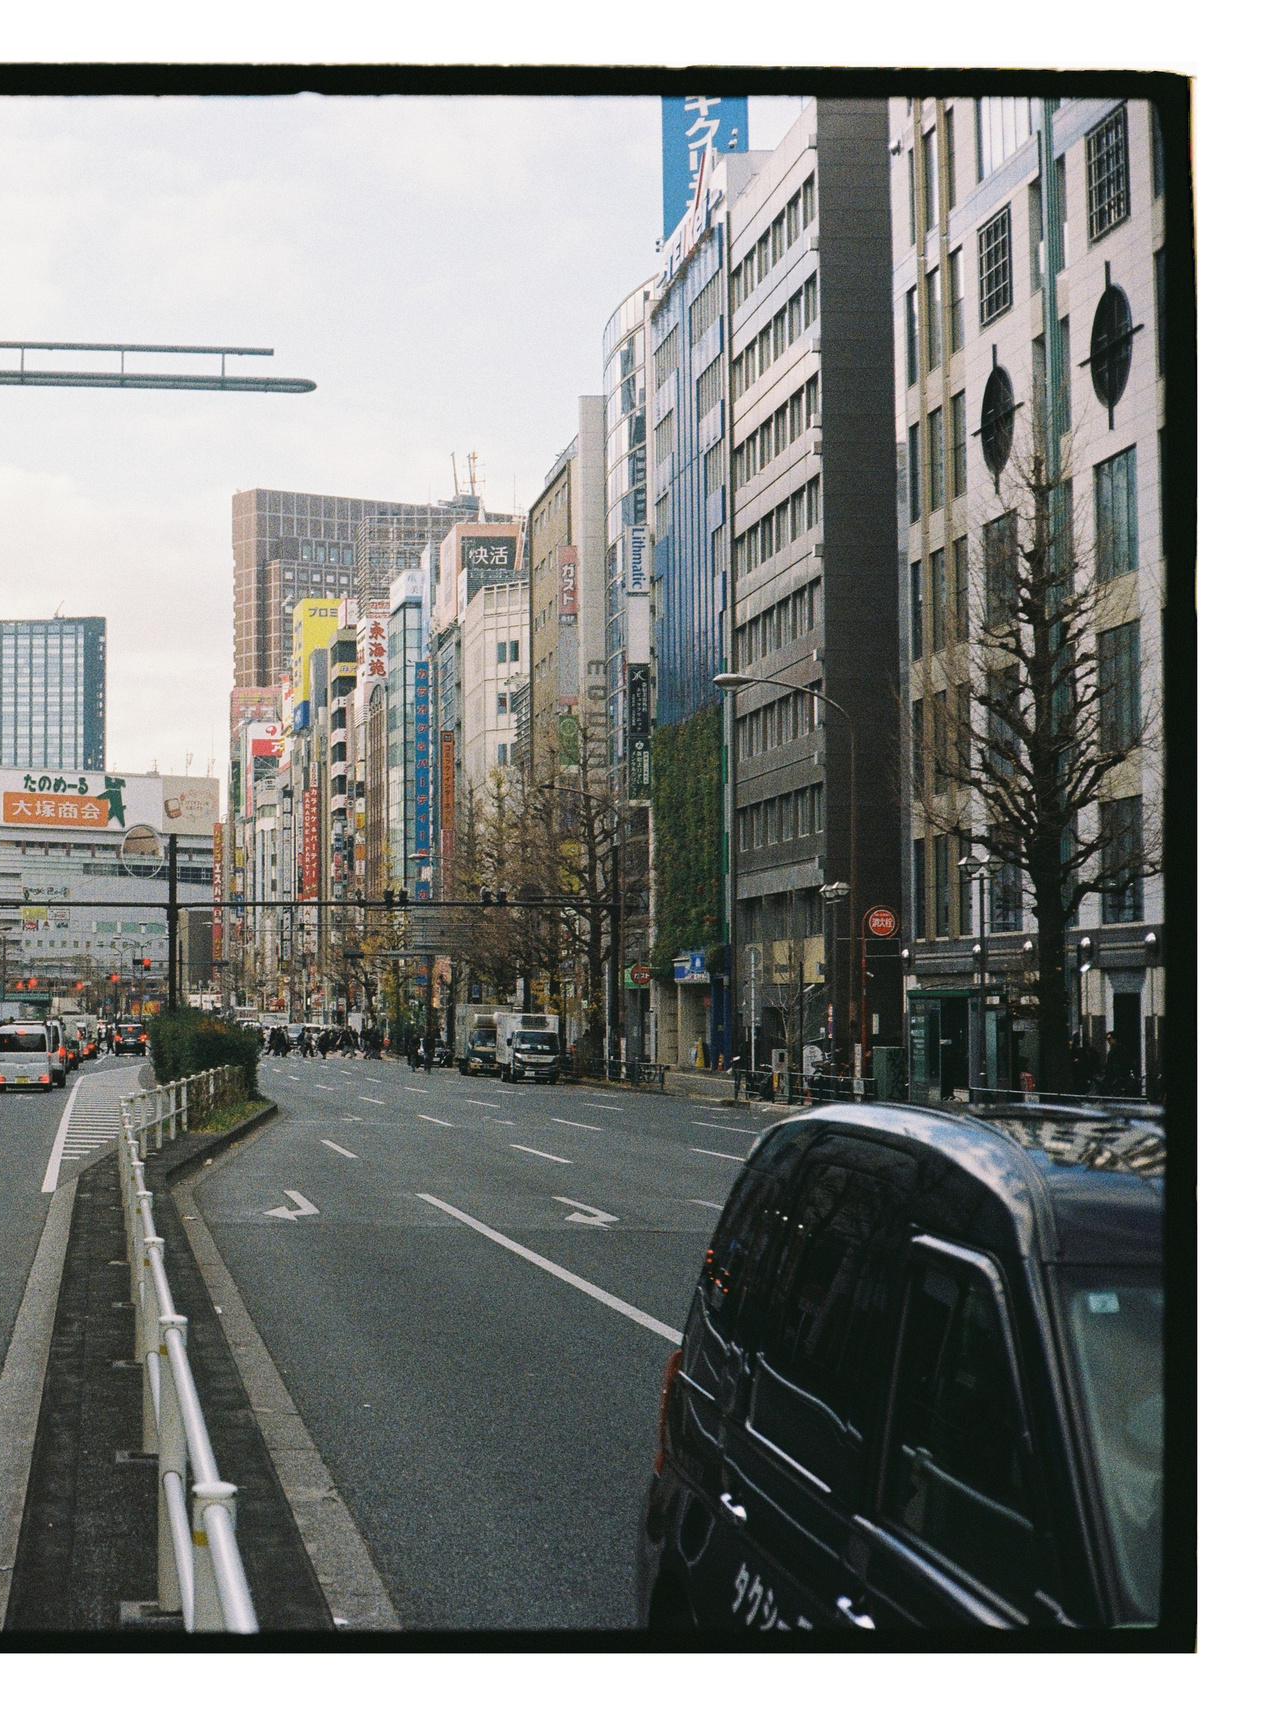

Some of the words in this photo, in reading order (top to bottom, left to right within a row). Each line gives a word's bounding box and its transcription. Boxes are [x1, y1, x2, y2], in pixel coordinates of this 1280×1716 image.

[468, 546, 508, 565] 快活
[631, 527, 646, 589] Lithmatic
[561, 564, 576, 606] ガスト
[368, 620, 387, 677] 東海苑
[23, 773, 89, 795] たのめーる
[12, 800, 101, 821] 大塚商会
